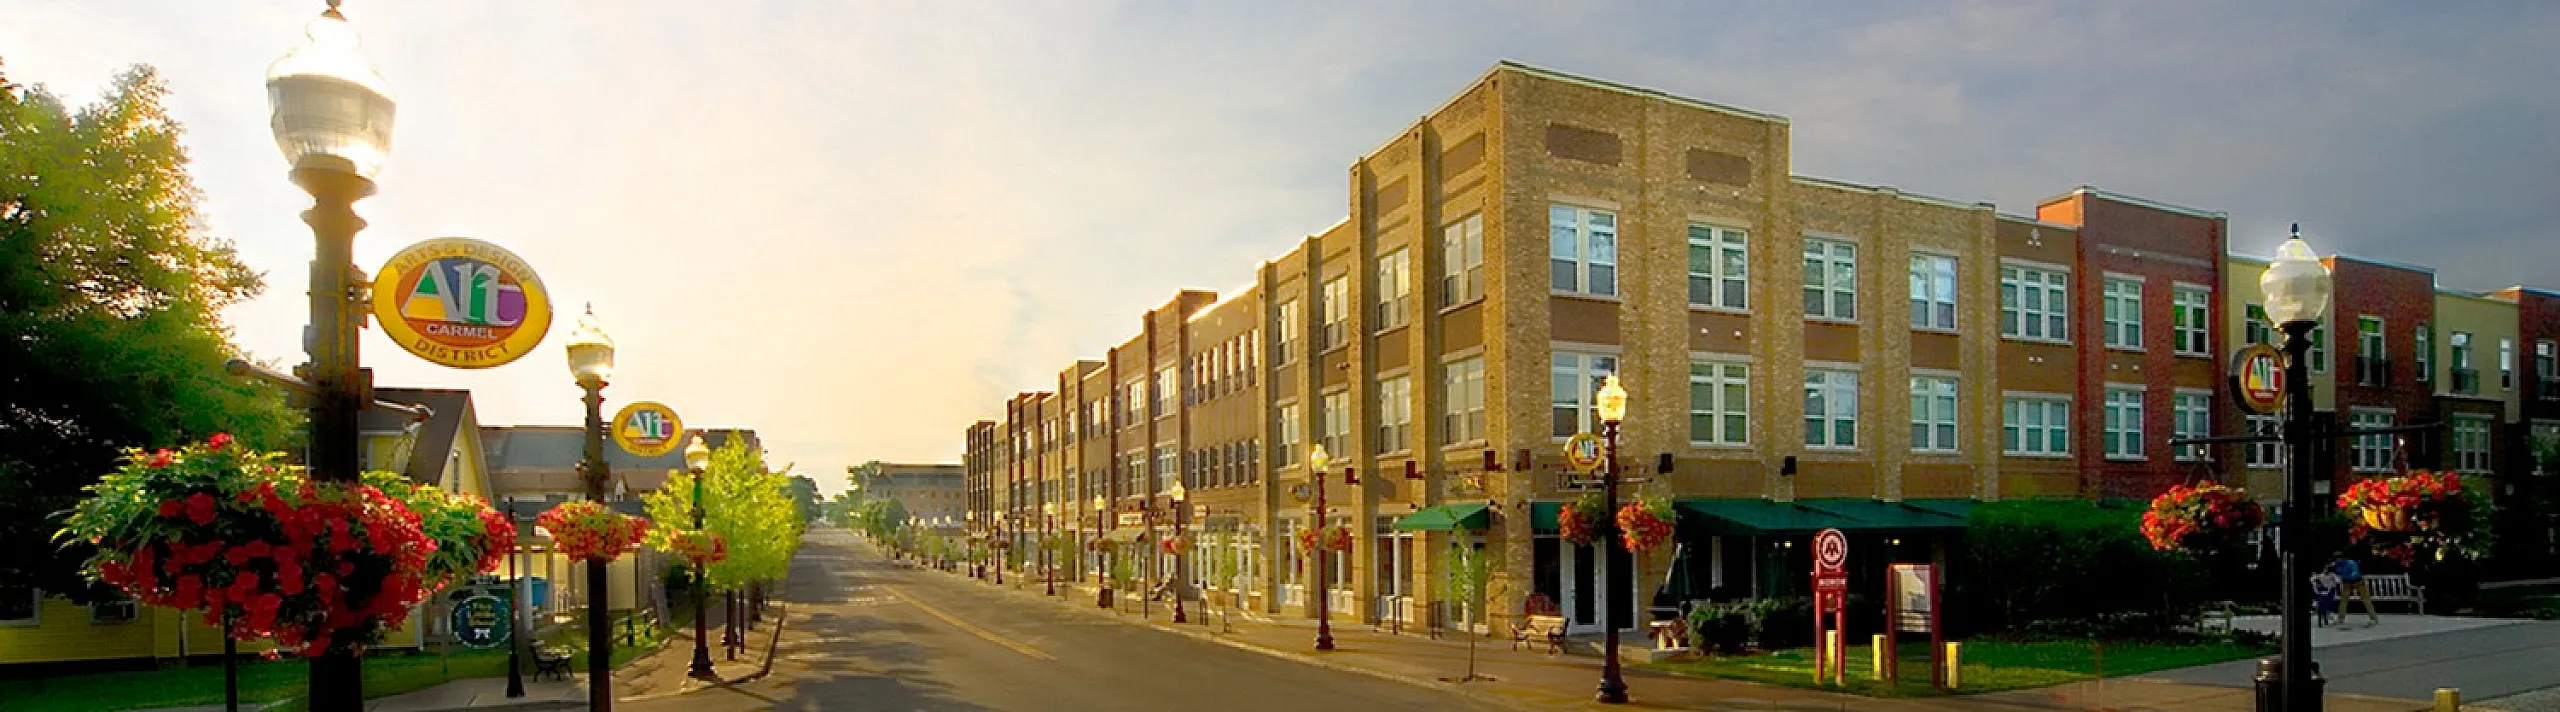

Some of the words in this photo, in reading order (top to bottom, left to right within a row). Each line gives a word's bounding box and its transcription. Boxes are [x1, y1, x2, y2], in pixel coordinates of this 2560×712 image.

[395, 243, 440, 271] ARTS
[464, 243, 532, 281] DESIGN
[426, 323, 498, 339] CARMEL
[414, 337, 508, 362] DISTRICT
